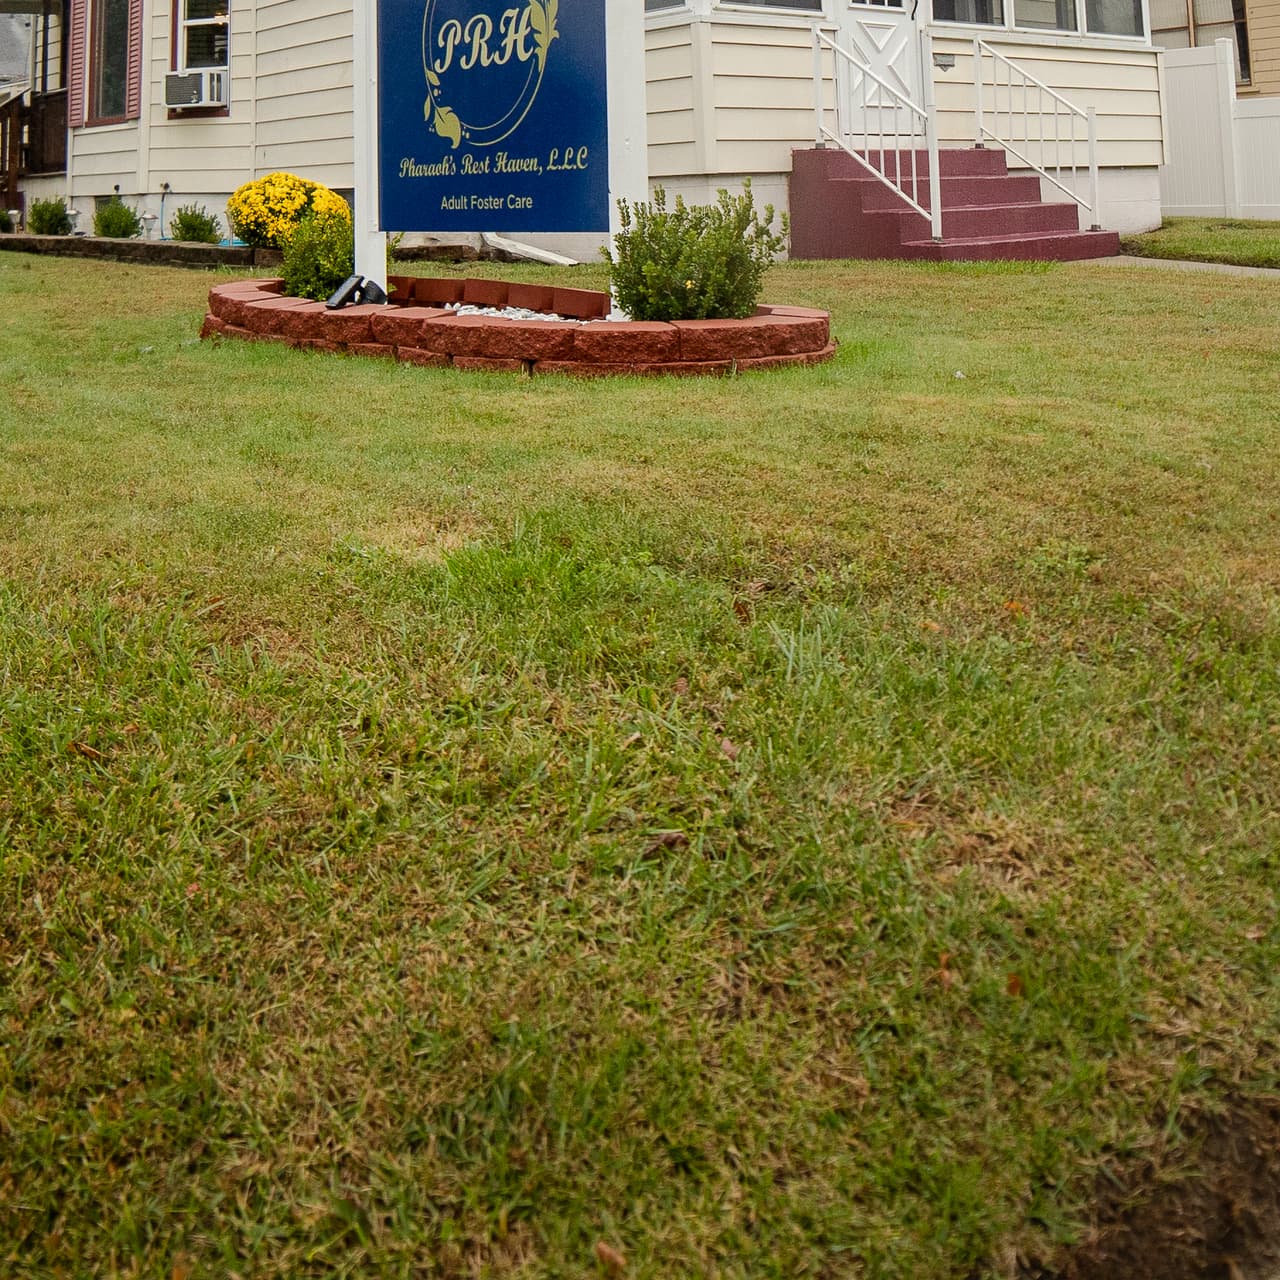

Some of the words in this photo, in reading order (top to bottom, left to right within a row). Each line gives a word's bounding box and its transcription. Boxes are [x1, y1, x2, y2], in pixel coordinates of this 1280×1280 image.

[434, 5, 534, 73] PRH
[399, 156, 456, 178] Pharaoh's
[460, 153, 490, 175] Rest
[493, 151, 543, 176] Haven,
[546, 146, 589, 170] L.L.C
[440, 195, 468, 210] Adult
[470, 195, 504, 210] Foster
[506, 194, 533, 209] Care
